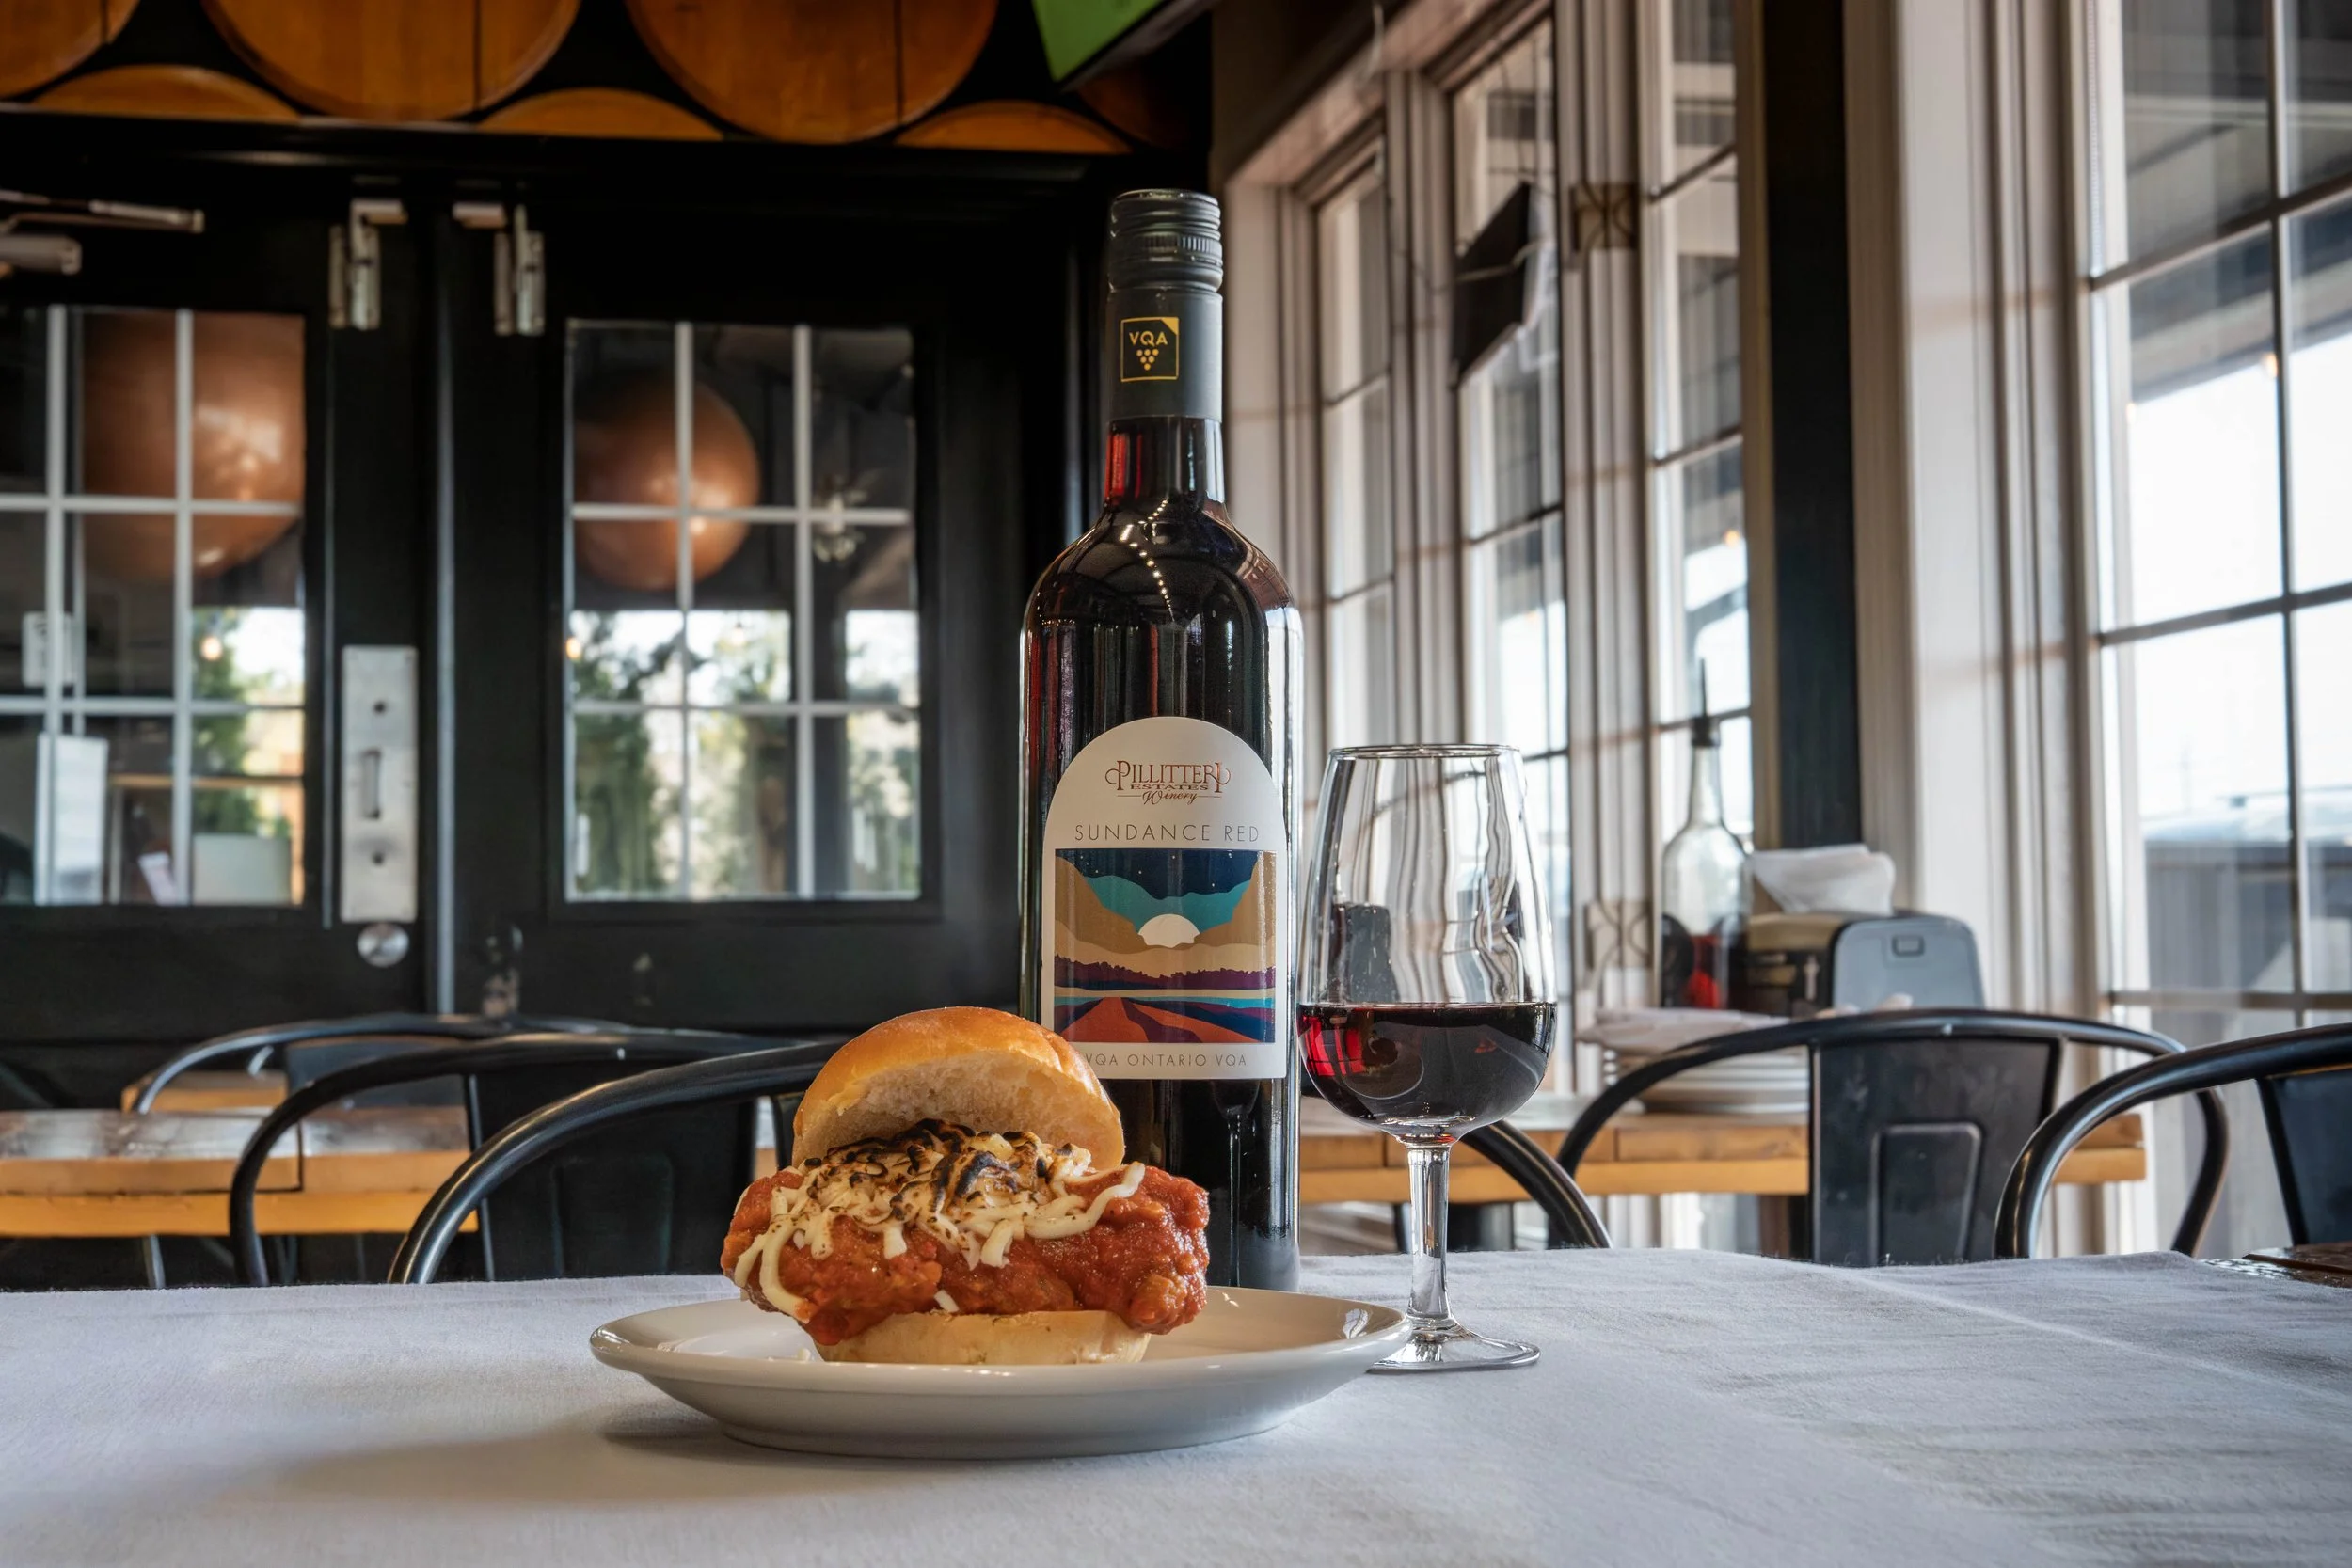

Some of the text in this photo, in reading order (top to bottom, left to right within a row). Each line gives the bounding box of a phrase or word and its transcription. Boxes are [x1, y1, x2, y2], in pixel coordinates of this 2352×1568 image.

[1129, 331, 1168, 347] VQA
[1104, 760, 1232, 793] PILLITTERI
[1142, 790, 1198, 805] Winery
[1074, 824, 1259, 842] SUNDANCE RED
[1085, 1053, 1247, 1067] VQA ONTARIO VQA
